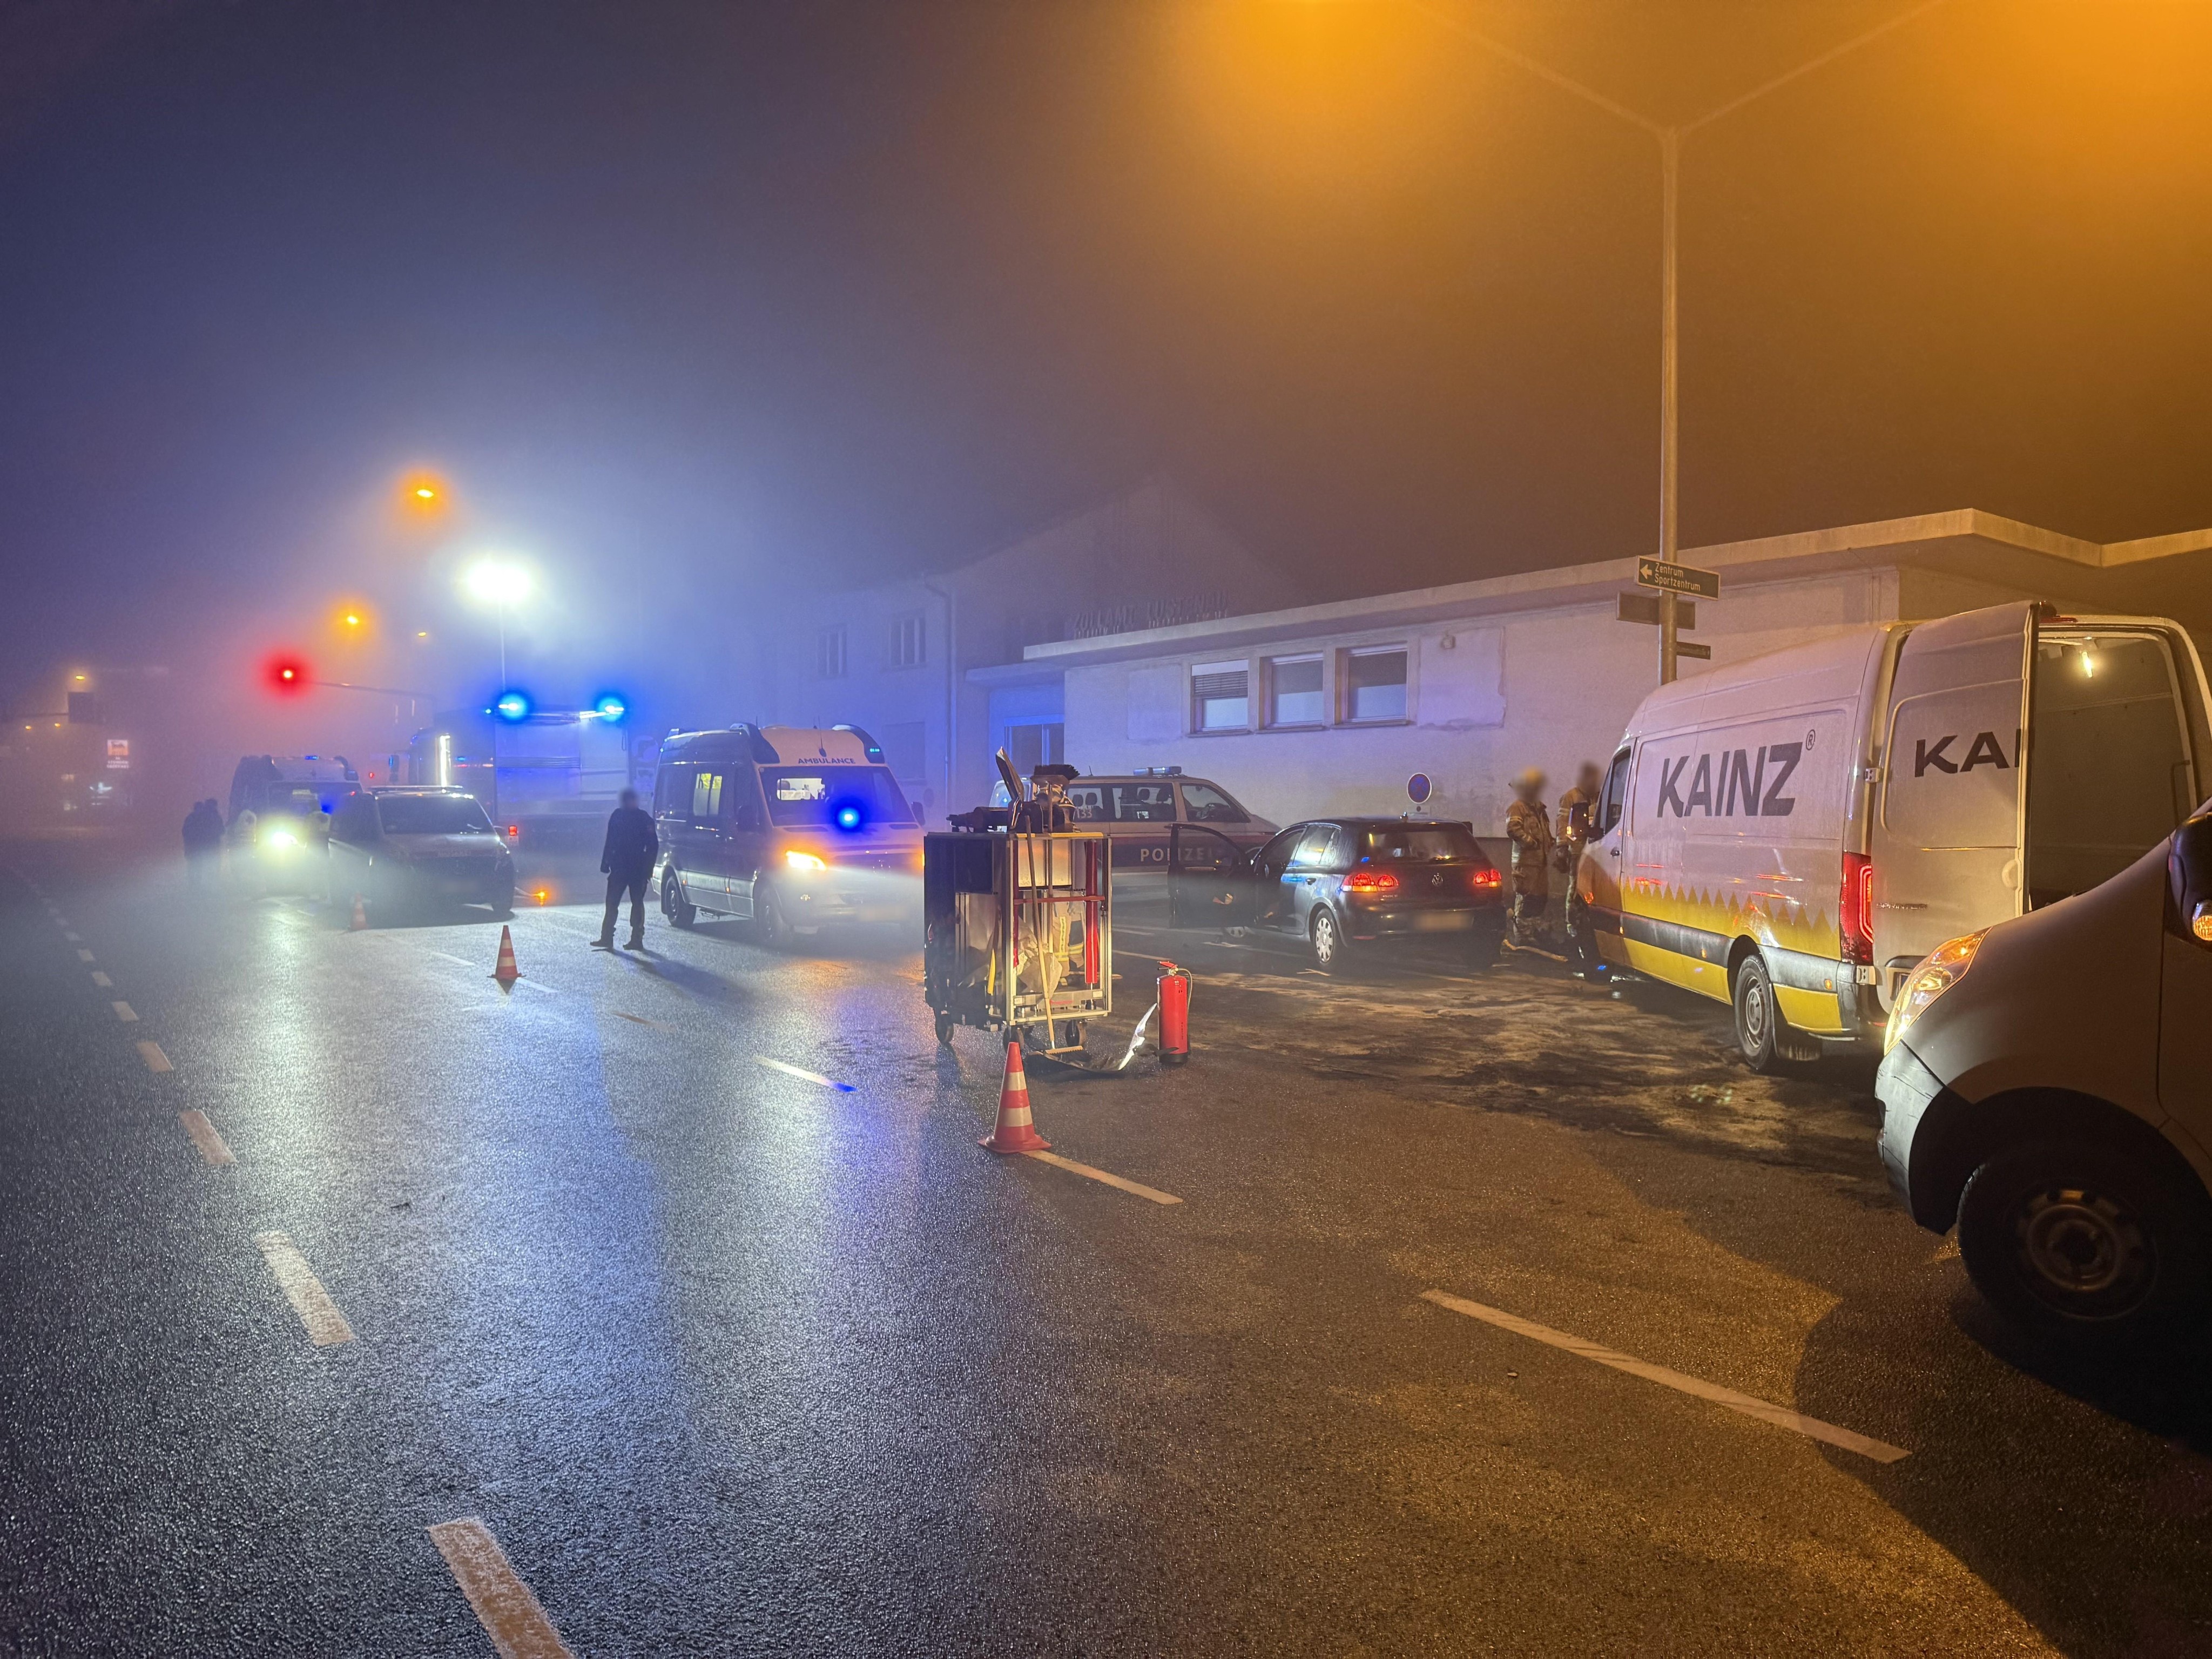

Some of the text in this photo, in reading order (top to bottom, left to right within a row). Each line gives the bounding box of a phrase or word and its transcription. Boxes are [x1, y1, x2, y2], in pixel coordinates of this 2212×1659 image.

[1655, 563, 1683, 577] Zentrum
[1655, 574, 1700, 591] Sportzentrum
[1657, 742, 1803, 818] KAINZ
